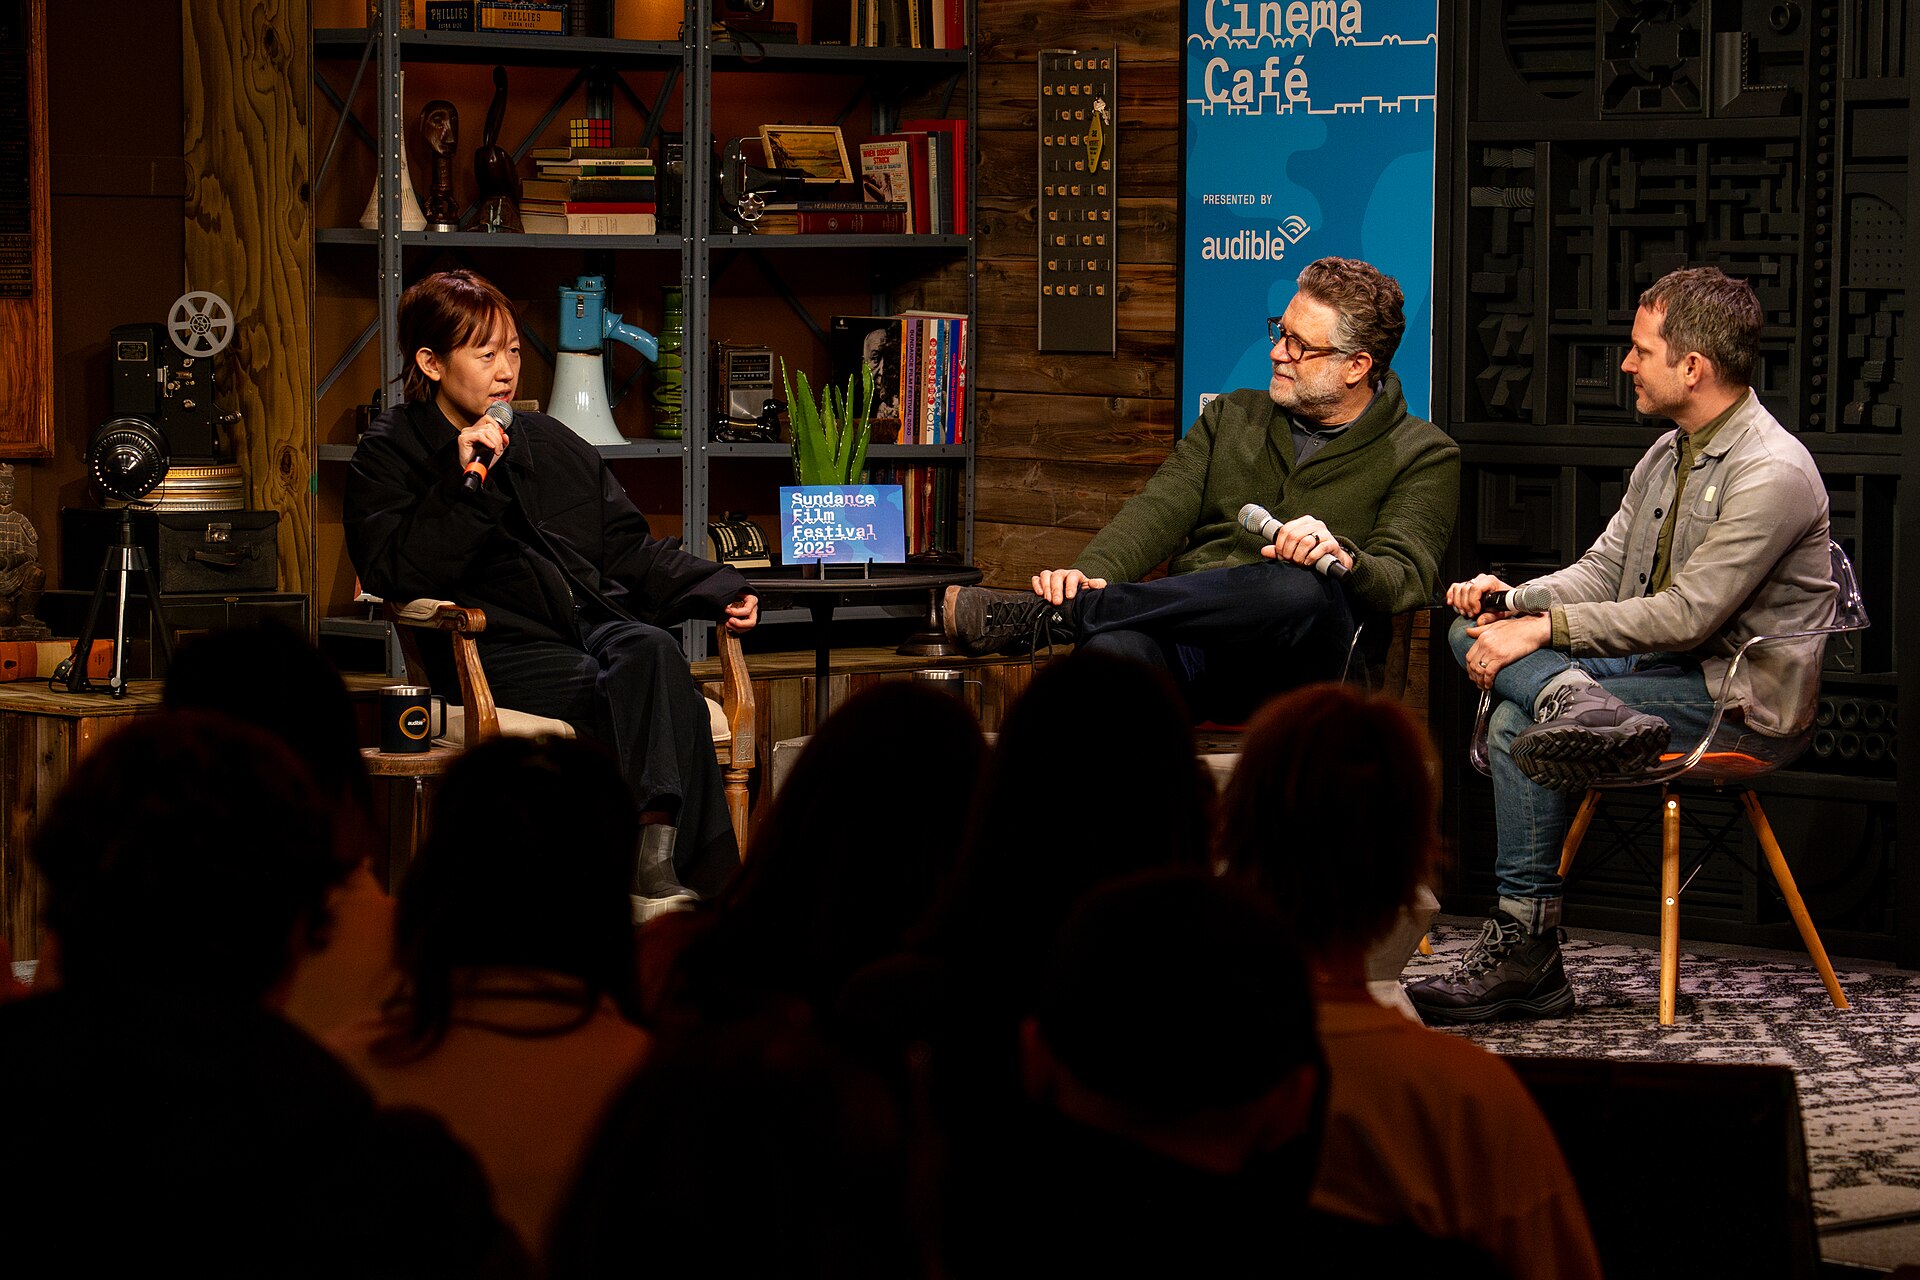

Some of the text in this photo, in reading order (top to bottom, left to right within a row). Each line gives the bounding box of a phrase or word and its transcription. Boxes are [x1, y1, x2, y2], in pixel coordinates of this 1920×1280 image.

[431, 8, 468, 20] PHILLIES
[503, 11, 541, 22] PHILLIES
[1205, 0, 1362, 37] Cinema
[1204, 55, 1309, 103] Café
[1203, 194, 1272, 205] PRESENTED BY
[1201, 230, 1285, 260] audible
[926, 407, 934, 432] 2014
[792, 492, 875, 507] Sundance
[793, 509, 835, 523] Film
[793, 524, 875, 540] Festival
[794, 541, 835, 555] 2025
